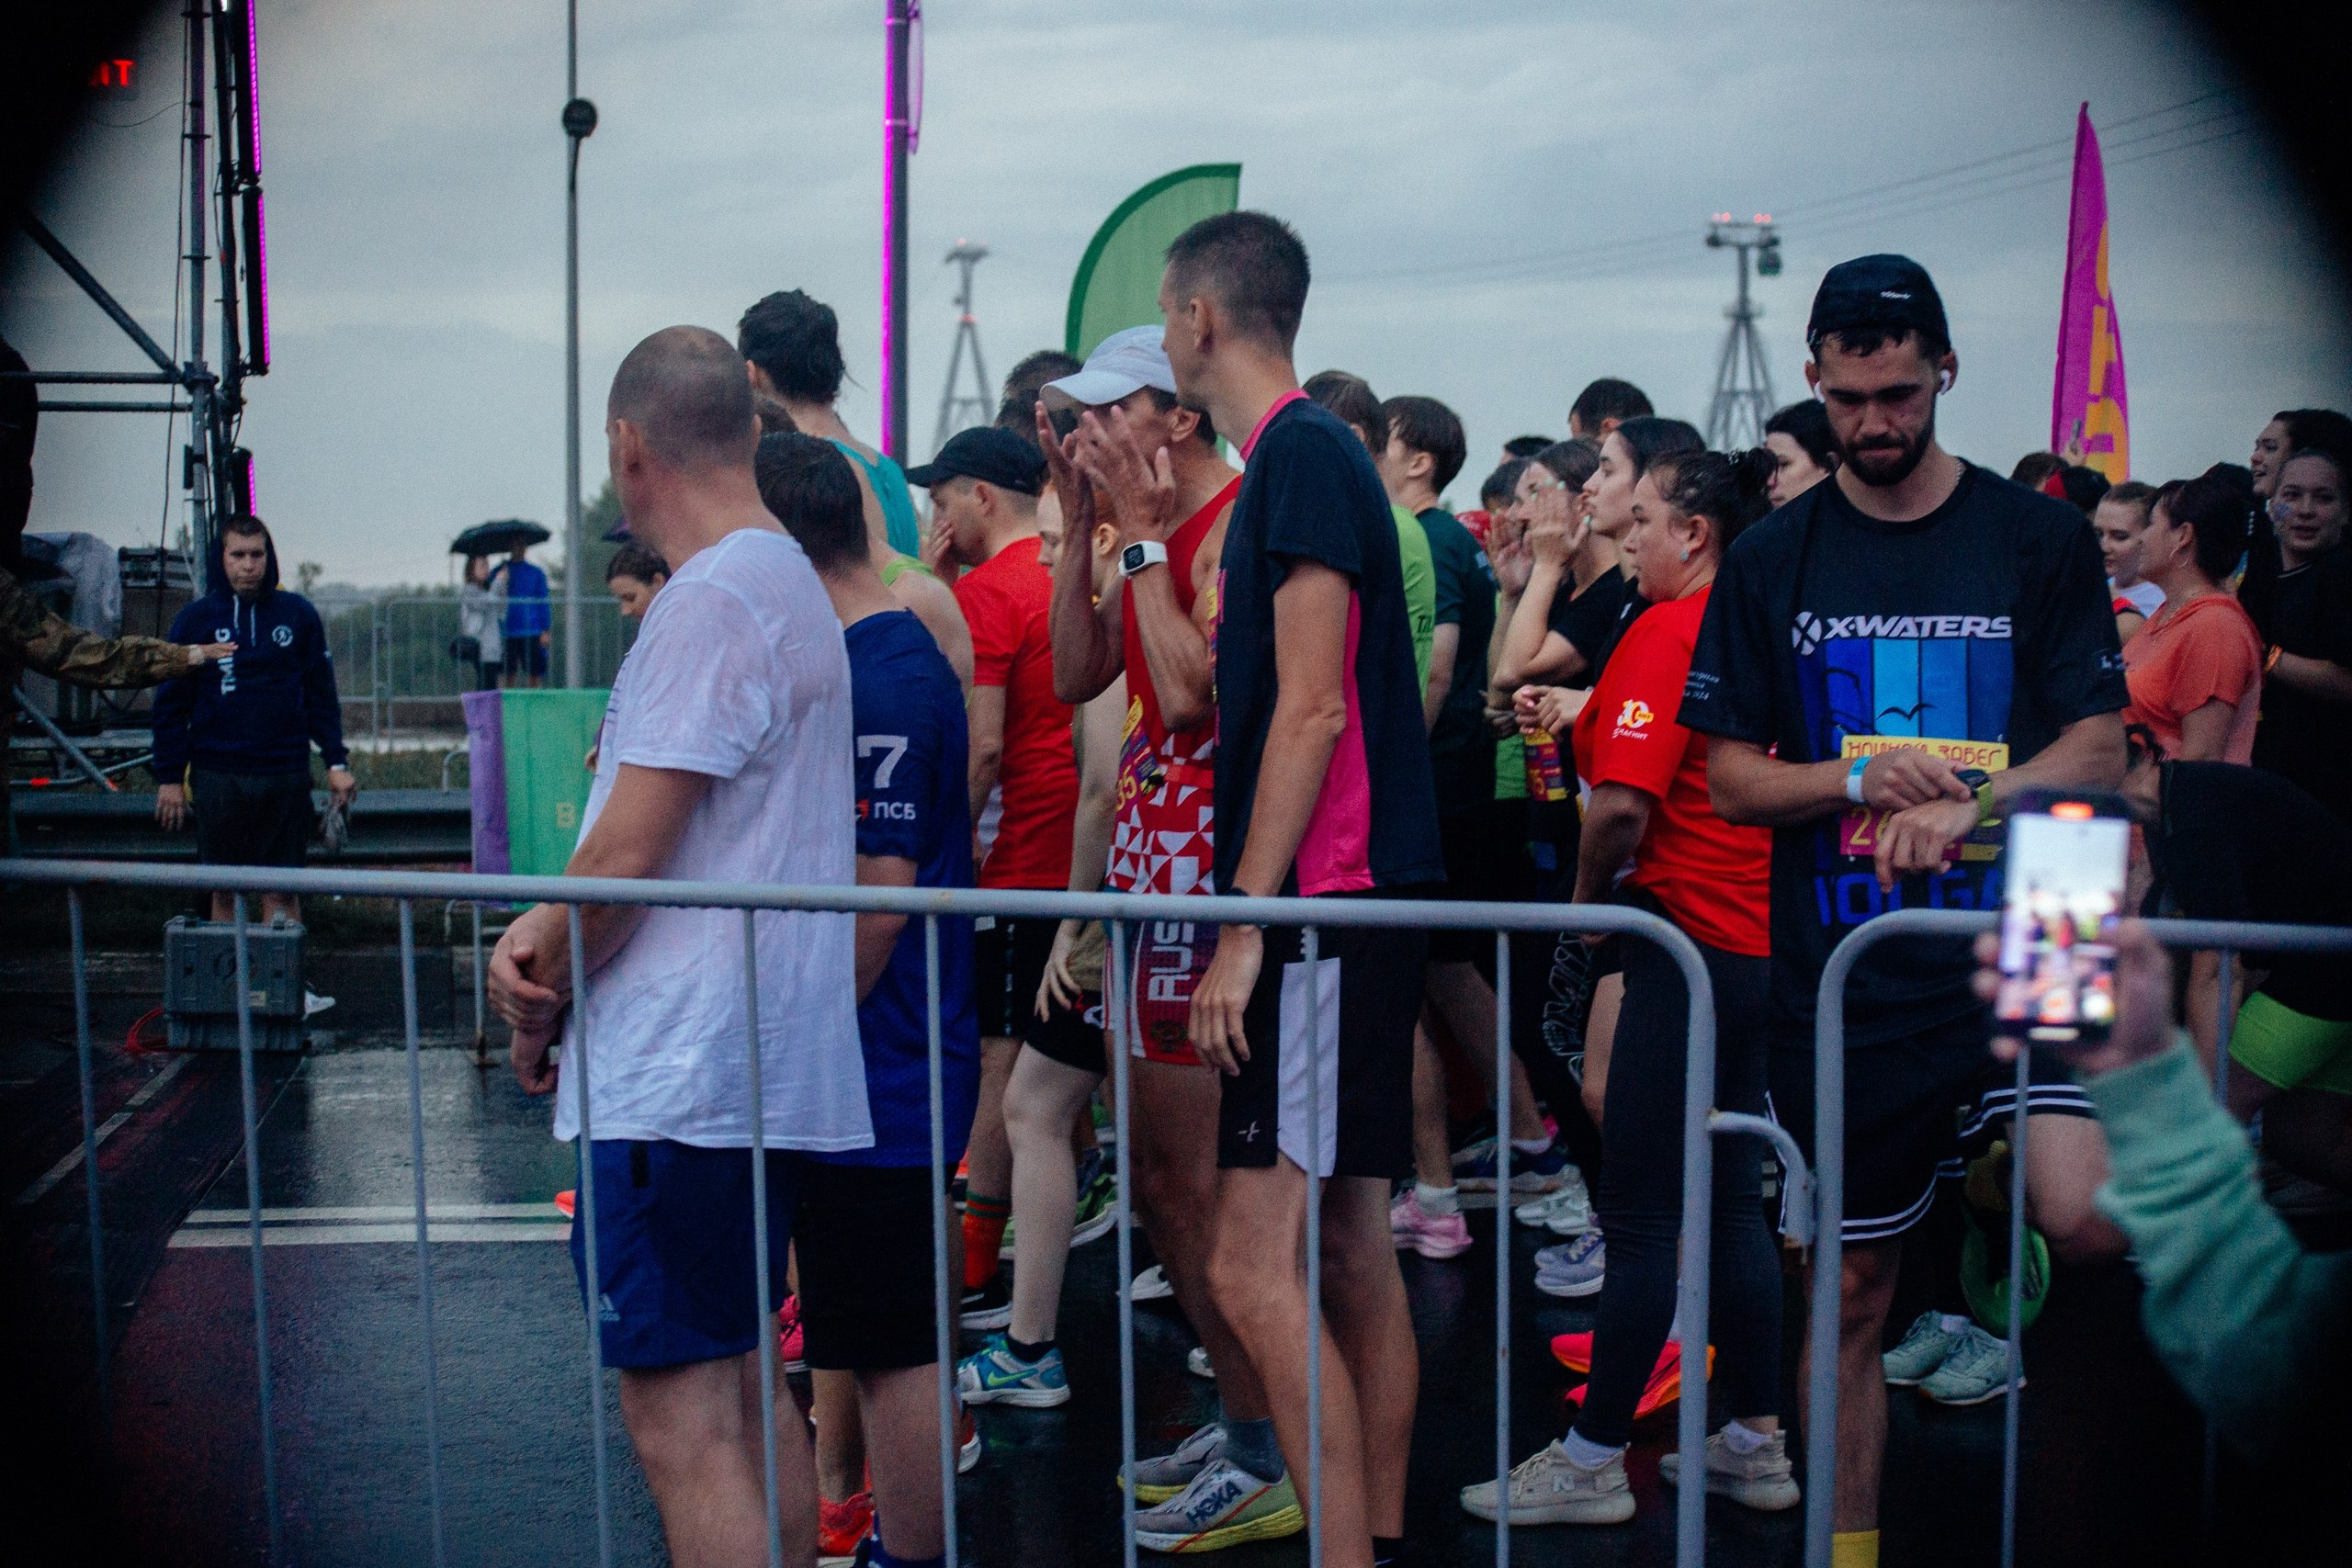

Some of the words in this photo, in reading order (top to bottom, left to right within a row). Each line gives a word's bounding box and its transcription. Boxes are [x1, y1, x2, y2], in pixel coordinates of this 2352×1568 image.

[856, 734, 909, 789] 7
[874, 801, 917, 820] ПСБ
[1186, 1481, 1244, 1527] HOKA
